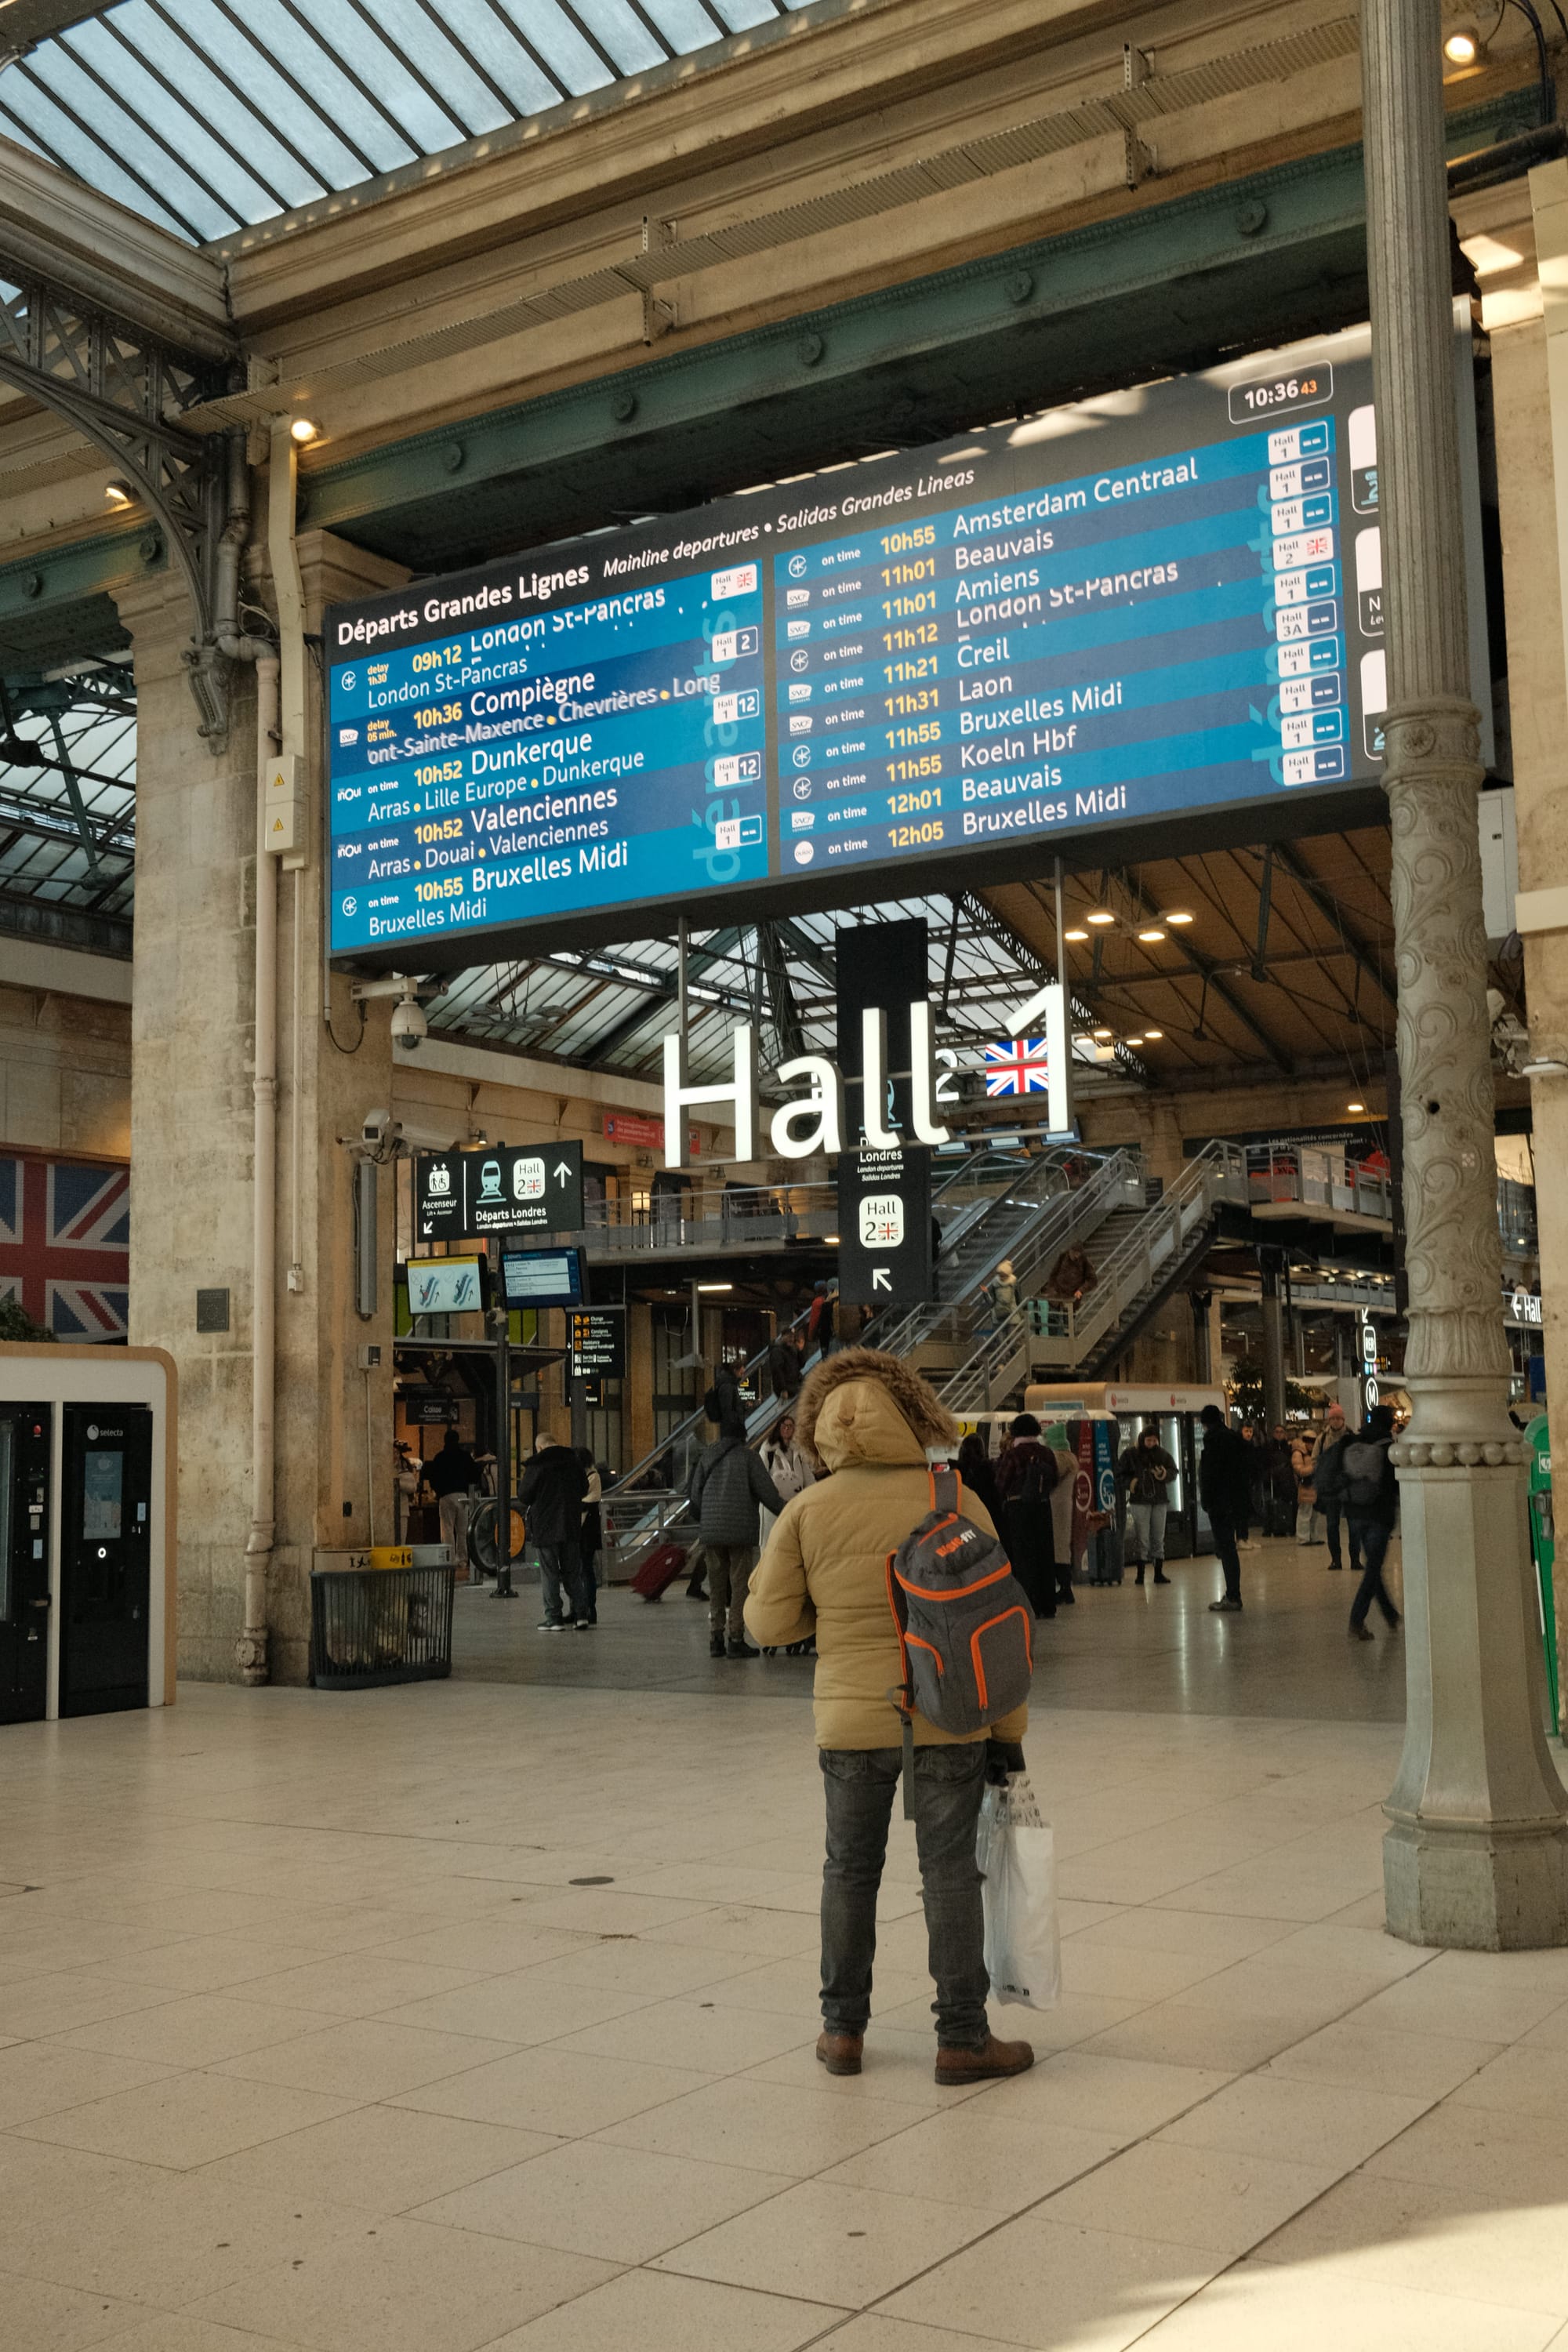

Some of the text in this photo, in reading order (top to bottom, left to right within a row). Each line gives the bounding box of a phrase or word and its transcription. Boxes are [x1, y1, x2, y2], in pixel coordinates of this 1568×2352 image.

[1244, 379, 1318, 409] 10:36 43
[1273, 434, 1294, 448] Hall
[1280, 448, 1287, 459] 1
[1275, 470, 1296, 483] Hall
[1282, 483, 1289, 494] 1
[822, 457, 1199, 566] on time 10h55 Amsterdam Centraal
[1276, 505, 1298, 518] Hall
[603, 470, 975, 579] Mainline departures Salidas Grandes Lineas
[1283, 518, 1290, 529] 1
[1278, 541, 1299, 554] Hall
[822, 529, 1054, 597] on time 11h01 Beauvais
[1285, 554, 1294, 564] 2
[715, 575, 731, 586] Hall
[1279, 576, 1301, 590] Hall
[823, 565, 1040, 630] on time 11h01 Amiens
[1287, 589, 1294, 601] 1
[338, 564, 590, 646] Départs Grandes Lignes
[824, 559, 1179, 662] on time 11h12 London St-Pancras
[1281, 612, 1302, 625] Hall
[412, 587, 666, 673] 09h12 London St-Pancras
[1283, 625, 1302, 637] 3A
[716, 637, 732, 648] Hall
[740, 635, 750, 650] 2
[1283, 648, 1304, 661] Hall
[367, 663, 389, 676] delay
[824, 636, 1010, 693] on time 11h21 Creil
[1290, 661, 1298, 672] 1
[367, 673, 387, 686] 1h30
[368, 658, 528, 709] London St-Pancras
[1284, 684, 1305, 697] Hall
[413, 672, 595, 729] 10h36 Compiègne
[717, 699, 734, 710] Hall
[739, 695, 756, 713] 12
[825, 672, 1013, 725] on time 11h31 Laon
[1292, 697, 1299, 708] 1
[367, 672, 720, 764] ont-Sainte-Maxence Chevrières Long
[826, 681, 1123, 757] on time 11h55 Bruxelles Midi
[367, 719, 389, 732] delay
[1287, 720, 1308, 733] Hall
[367, 731, 378, 743] 05
[1294, 733, 1301, 744] 1
[368, 732, 593, 794] on time 10h52 Dunkerque
[826, 724, 1076, 789] on time 11h55 Koeln Hbf
[1288, 757, 1309, 769] Hall
[718, 761, 735, 772] Hall
[739, 758, 757, 776] 12
[1295, 768, 1303, 780] 1
[368, 750, 644, 822] Arras Lille Europe Dunkerque
[827, 764, 1062, 822] on time 12h01 Beauvais
[368, 786, 619, 851] on time 10h52 Valenciennes
[828, 786, 1127, 855] on time 12h05 Bruxelles Midi
[720, 825, 736, 835] Hall
[368, 820, 609, 880] Arras Douai Valenciennes
[368, 840, 629, 909] on time 10h55 Bruxelles Midi
[369, 898, 487, 937] Bruxelles Midi
[663, 983, 1069, 1168] Hall 1
[1278, 1134, 1317, 1144] nationalités
[1318, 1131, 1354, 1142] concernées
[859, 1149, 902, 1163] Londres
[518, 1163, 540, 1175] Hall
[857, 1163, 904, 1174] London departures
[861, 1174, 880, 1182] Salidas
[517, 1180, 526, 1195] 2
[422, 1200, 457, 1210] Ascenseur
[866, 1201, 896, 1216] Hall
[475, 1206, 546, 1223] Départs Londres
[866, 1221, 877, 1241] 2
[1524, 1296, 1542, 1323] Hall
[100, 1428, 124, 1438] selecta
